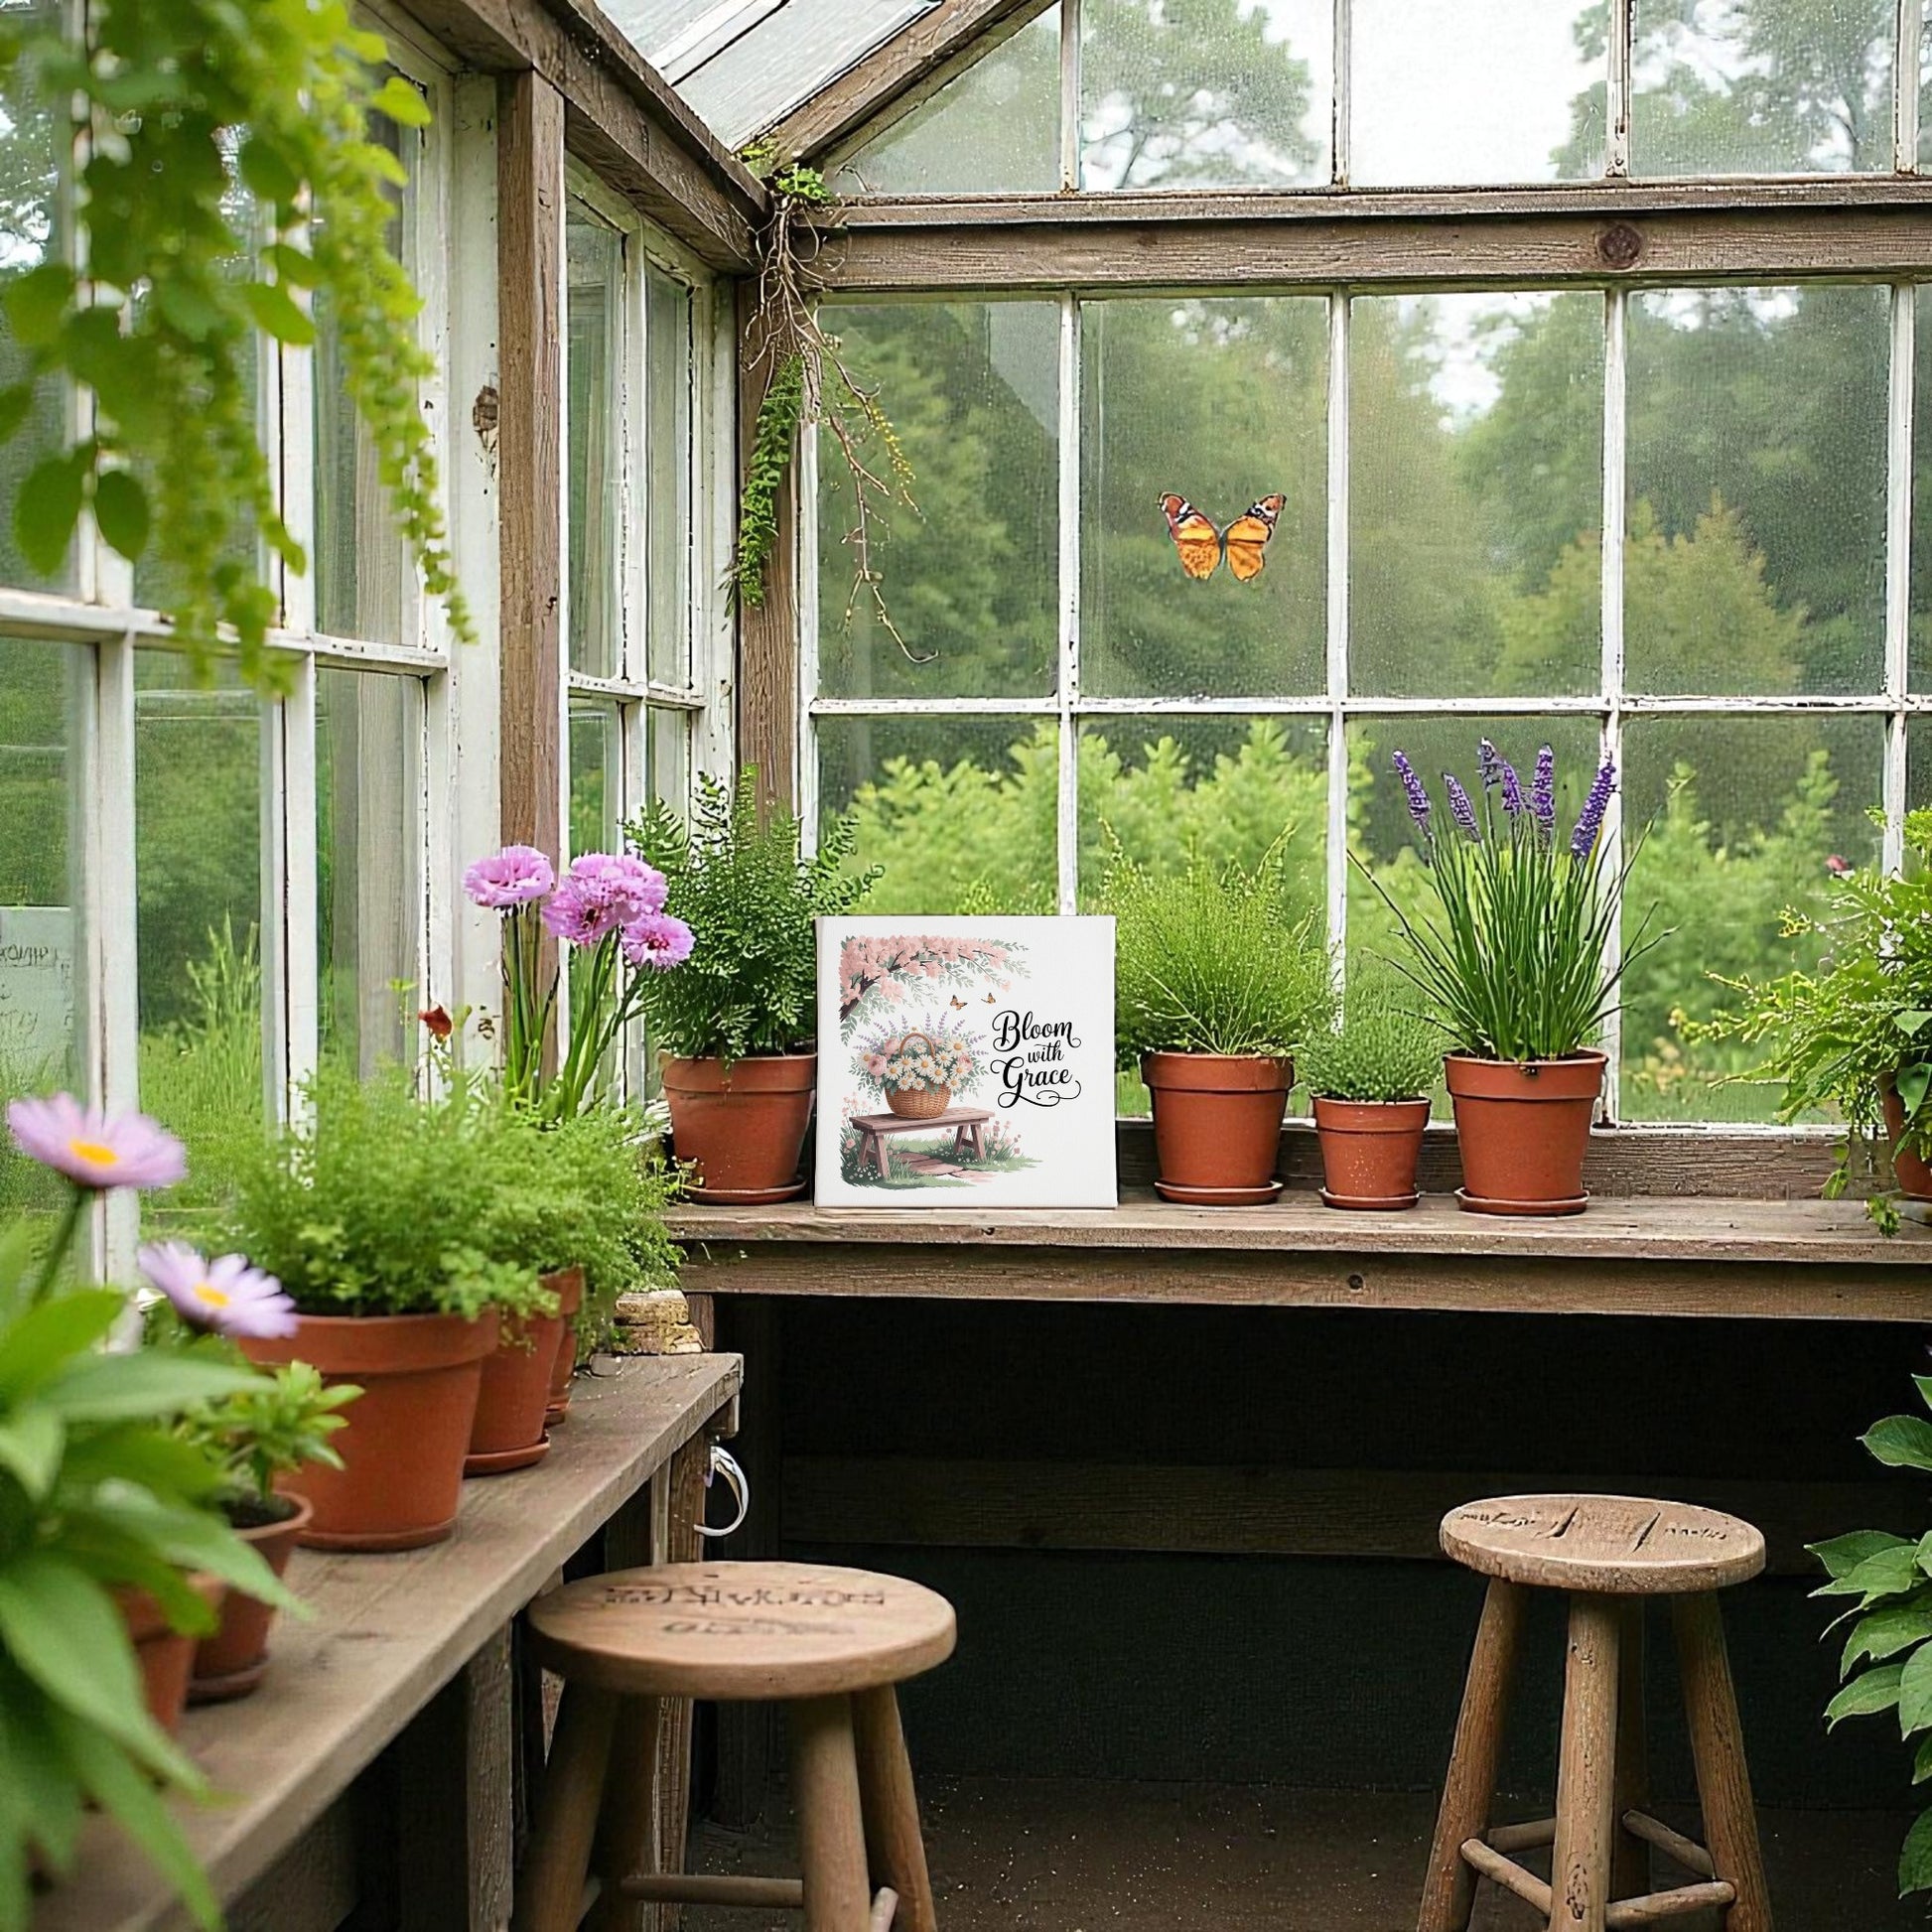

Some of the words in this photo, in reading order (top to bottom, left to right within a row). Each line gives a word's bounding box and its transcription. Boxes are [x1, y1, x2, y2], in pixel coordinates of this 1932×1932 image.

[992, 1010, 1082, 1052] Bloom
[1028, 1039, 1065, 1063] with
[990, 1056, 1082, 1109] Grace
